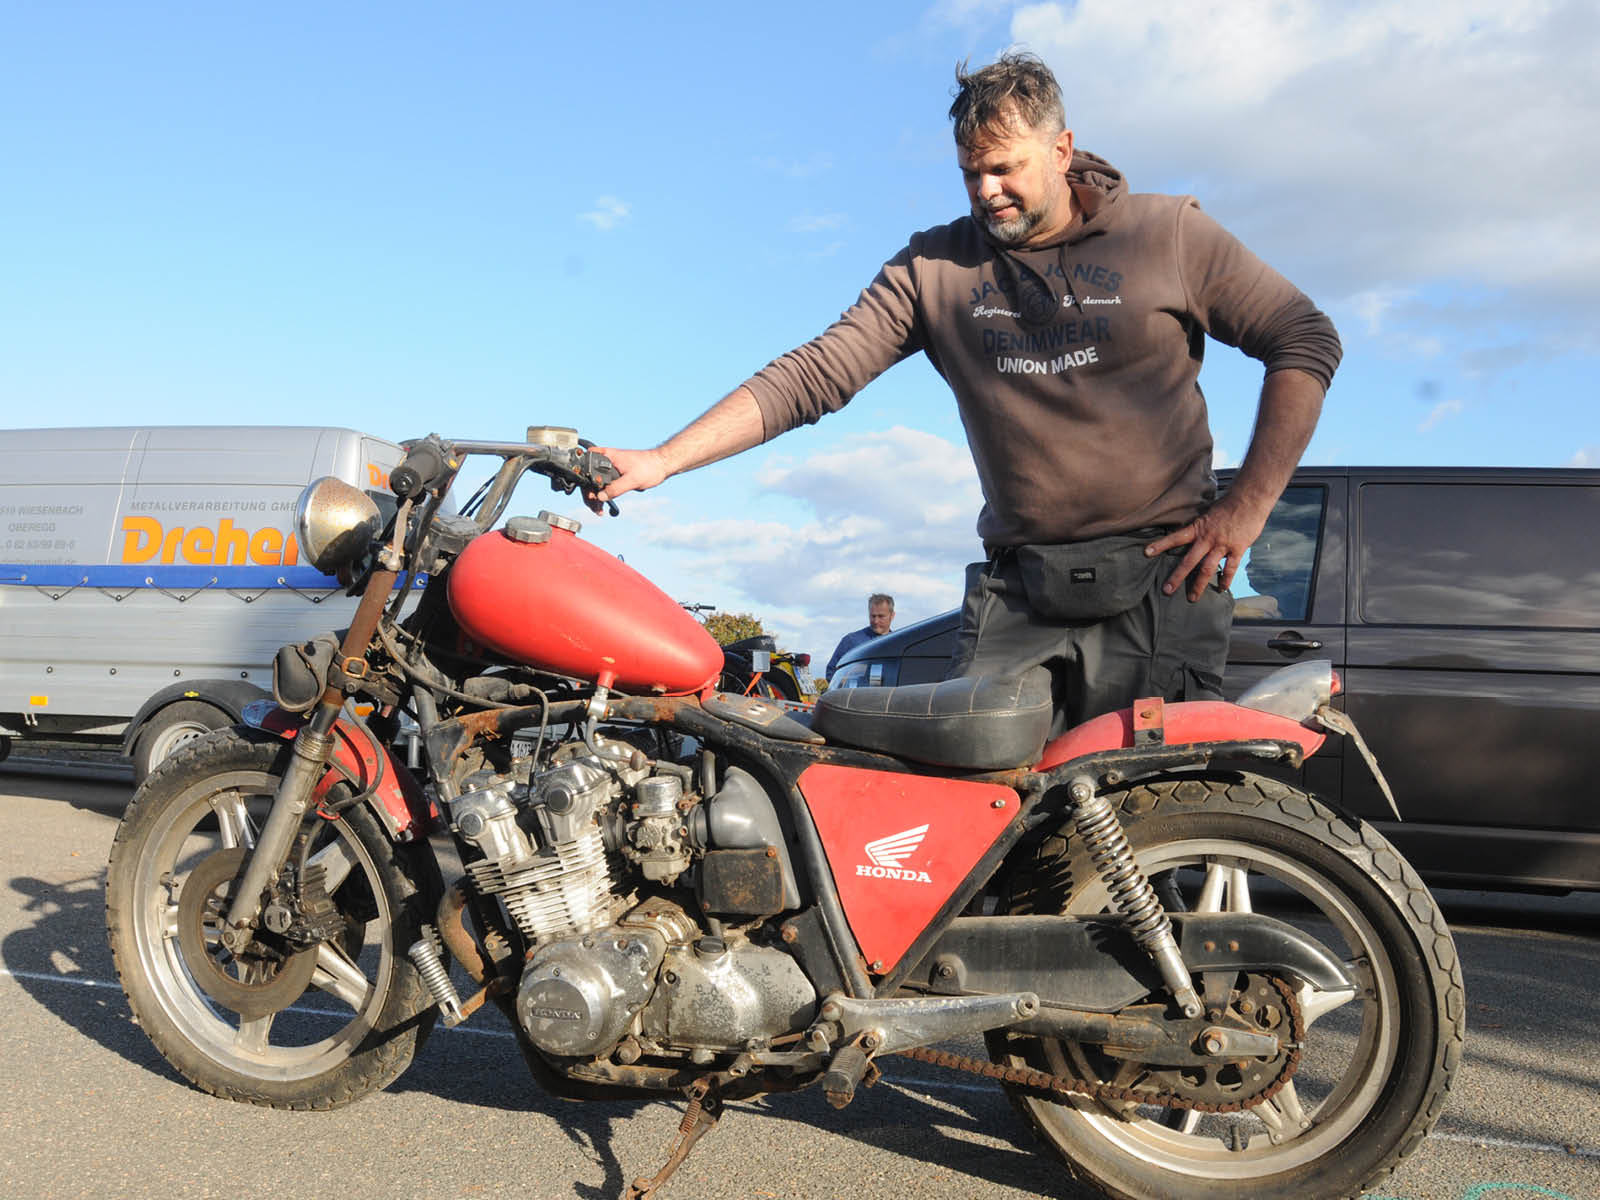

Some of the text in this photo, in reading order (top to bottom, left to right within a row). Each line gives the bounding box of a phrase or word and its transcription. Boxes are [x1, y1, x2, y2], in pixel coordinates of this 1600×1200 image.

[1063, 295, 1122, 308] Tdemark
[982, 316, 1112, 354] DENIMWEAR
[996, 346, 1099, 375] UNION MADE
[130, 501, 266, 512] METALLVERARBEITUNG
[856, 865, 932, 883] HONDA
[530, 1007, 584, 1020] HONDA
